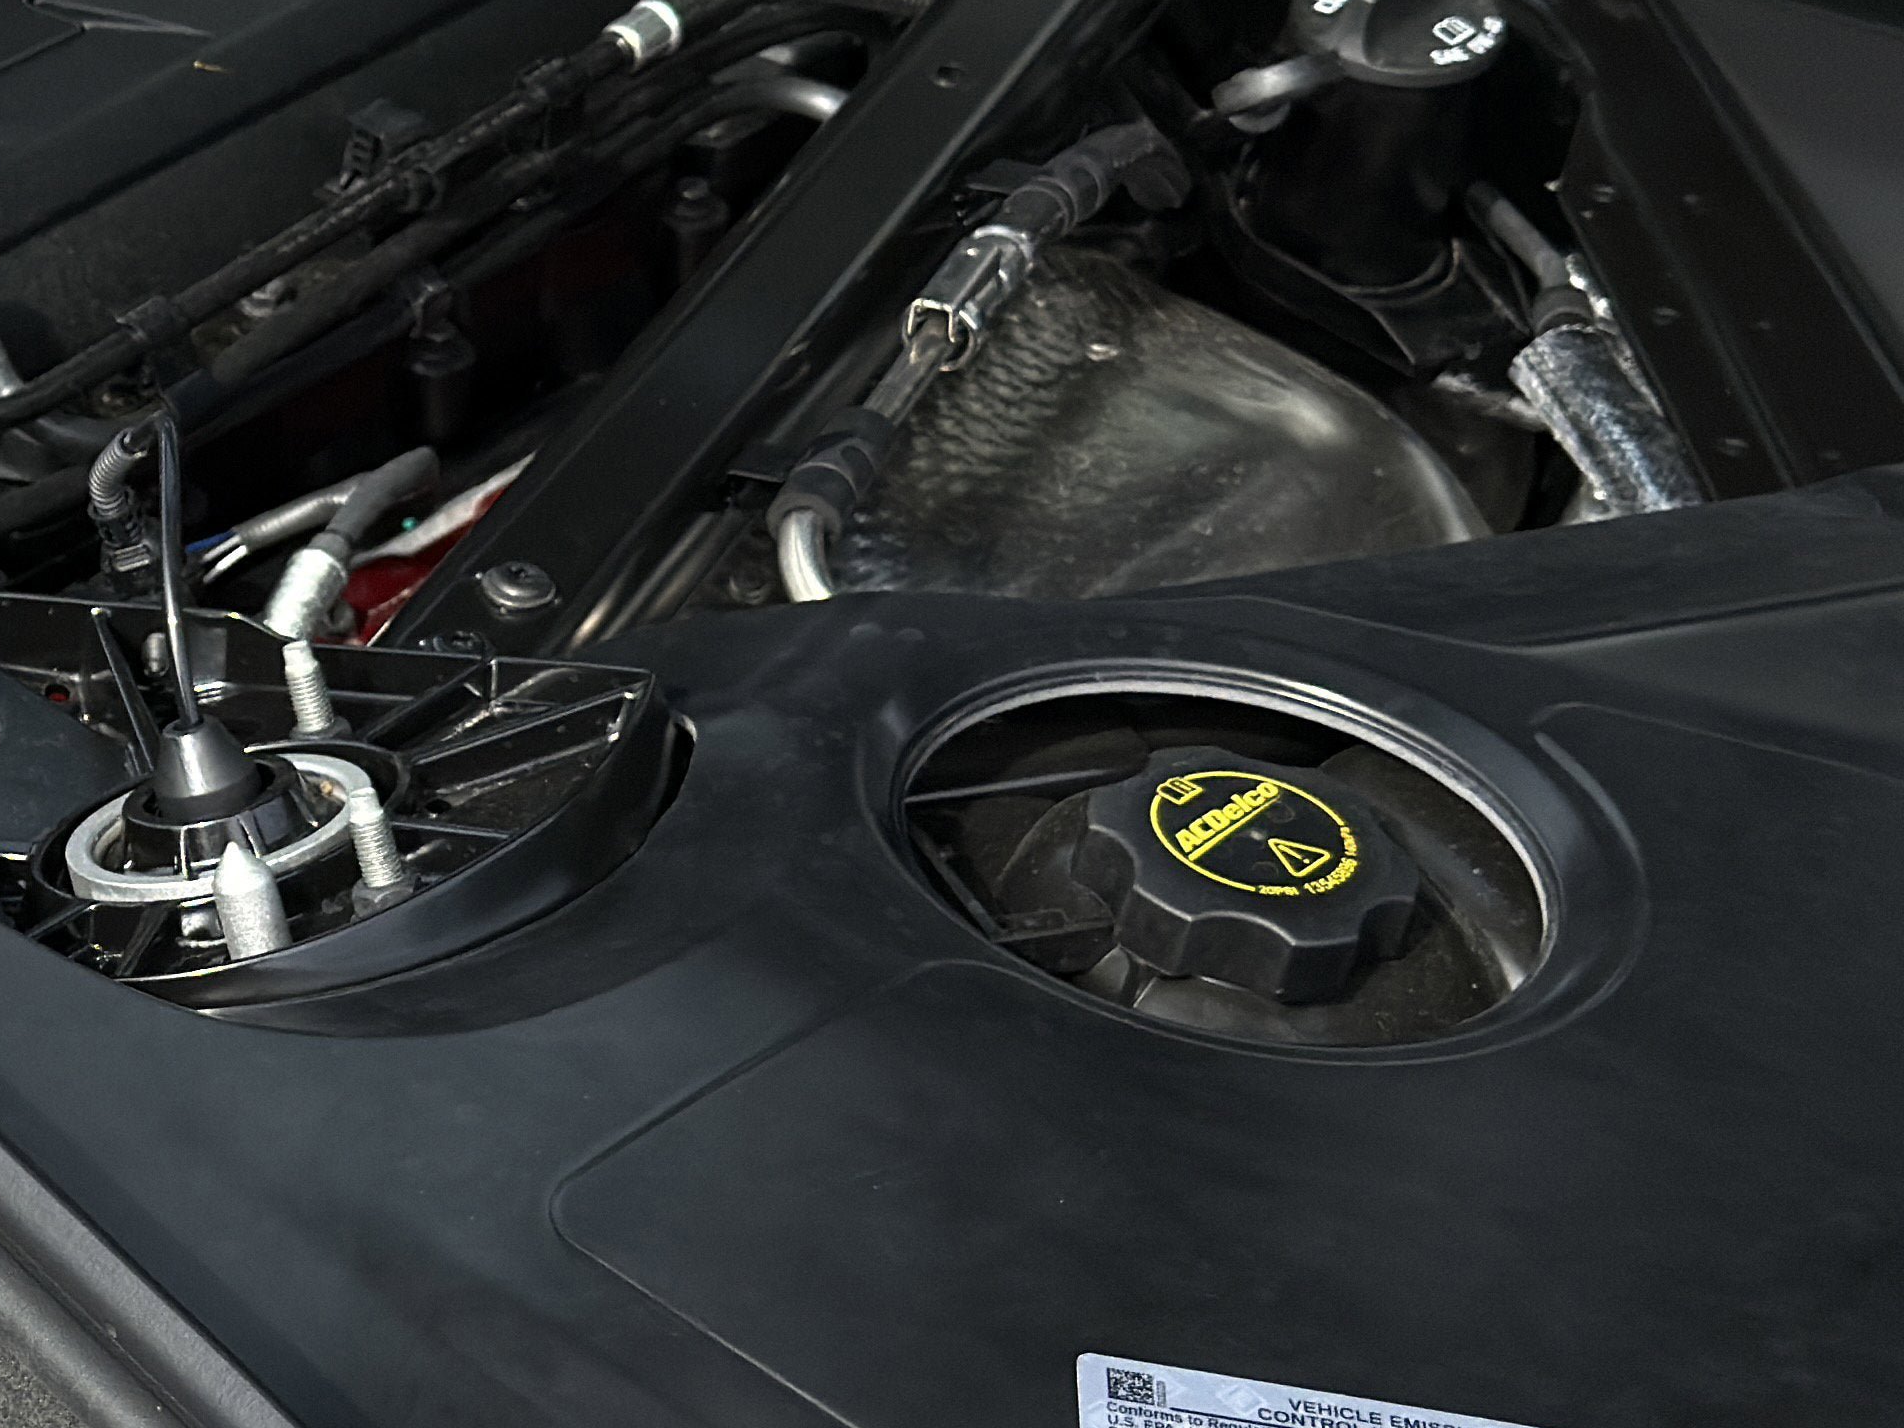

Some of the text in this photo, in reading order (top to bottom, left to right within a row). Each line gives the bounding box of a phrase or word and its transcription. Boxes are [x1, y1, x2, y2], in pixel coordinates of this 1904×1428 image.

[1175, 782, 1279, 853] ACDelco
[1106, 1401, 1183, 1422] Conforms
[1187, 1414, 1203, 1426] to
[1107, 1413, 1138, 1428] U.S.
[1288, 1398, 1382, 1424] VEHICLE
